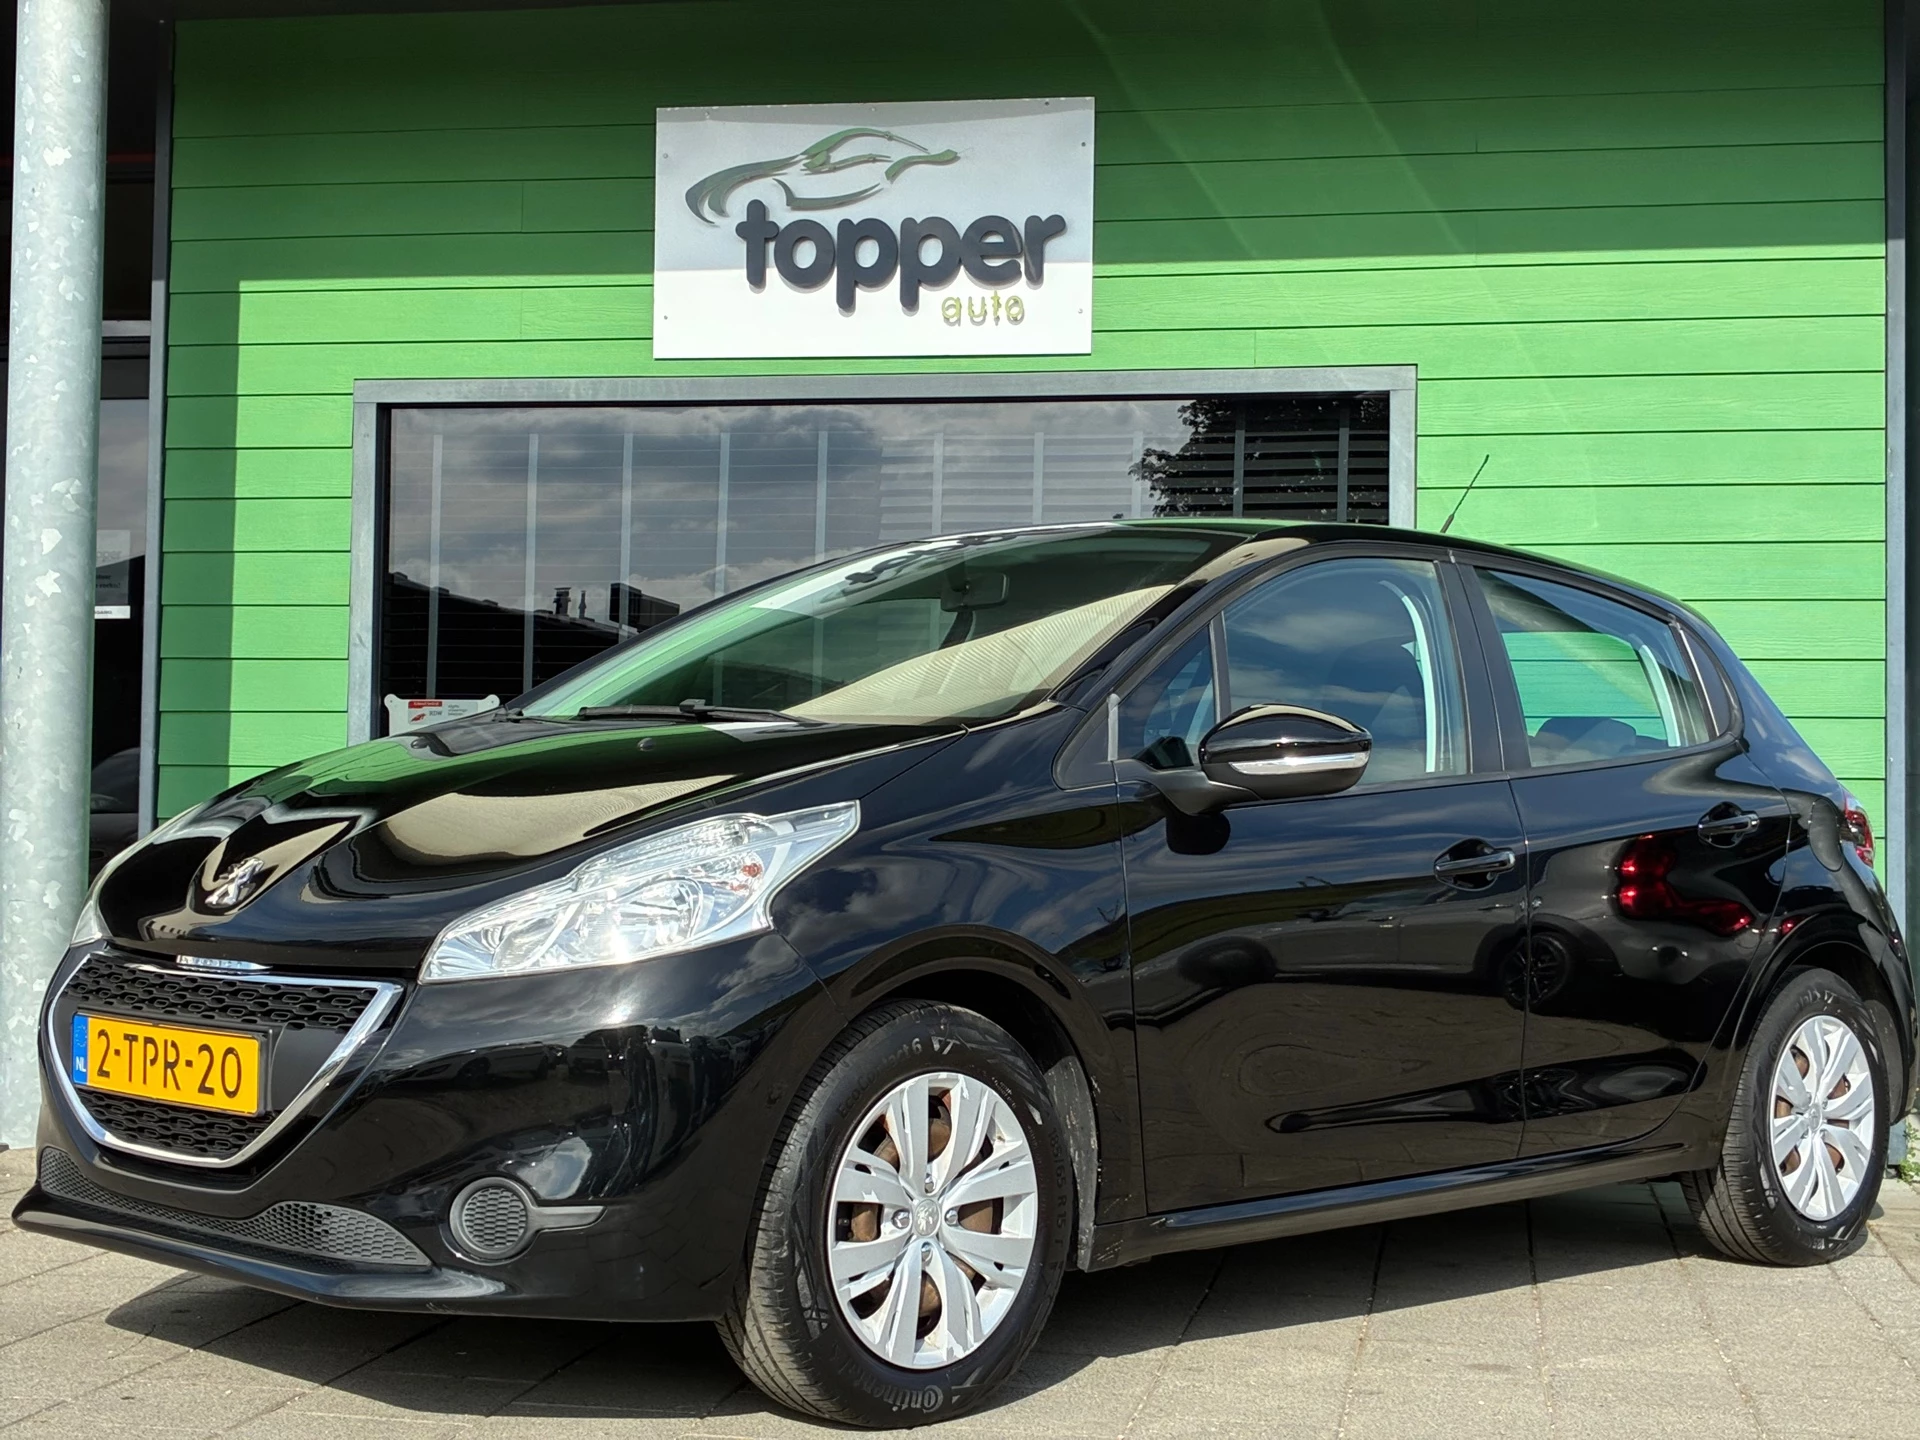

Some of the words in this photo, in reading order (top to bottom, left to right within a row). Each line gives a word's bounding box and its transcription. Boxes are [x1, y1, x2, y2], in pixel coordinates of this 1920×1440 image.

[735, 199, 1067, 312] topper
[940, 290, 1025, 325] auto
[75, 1056, 87, 1072] NL
[97, 1028, 242, 1099] 2-TPR-20
